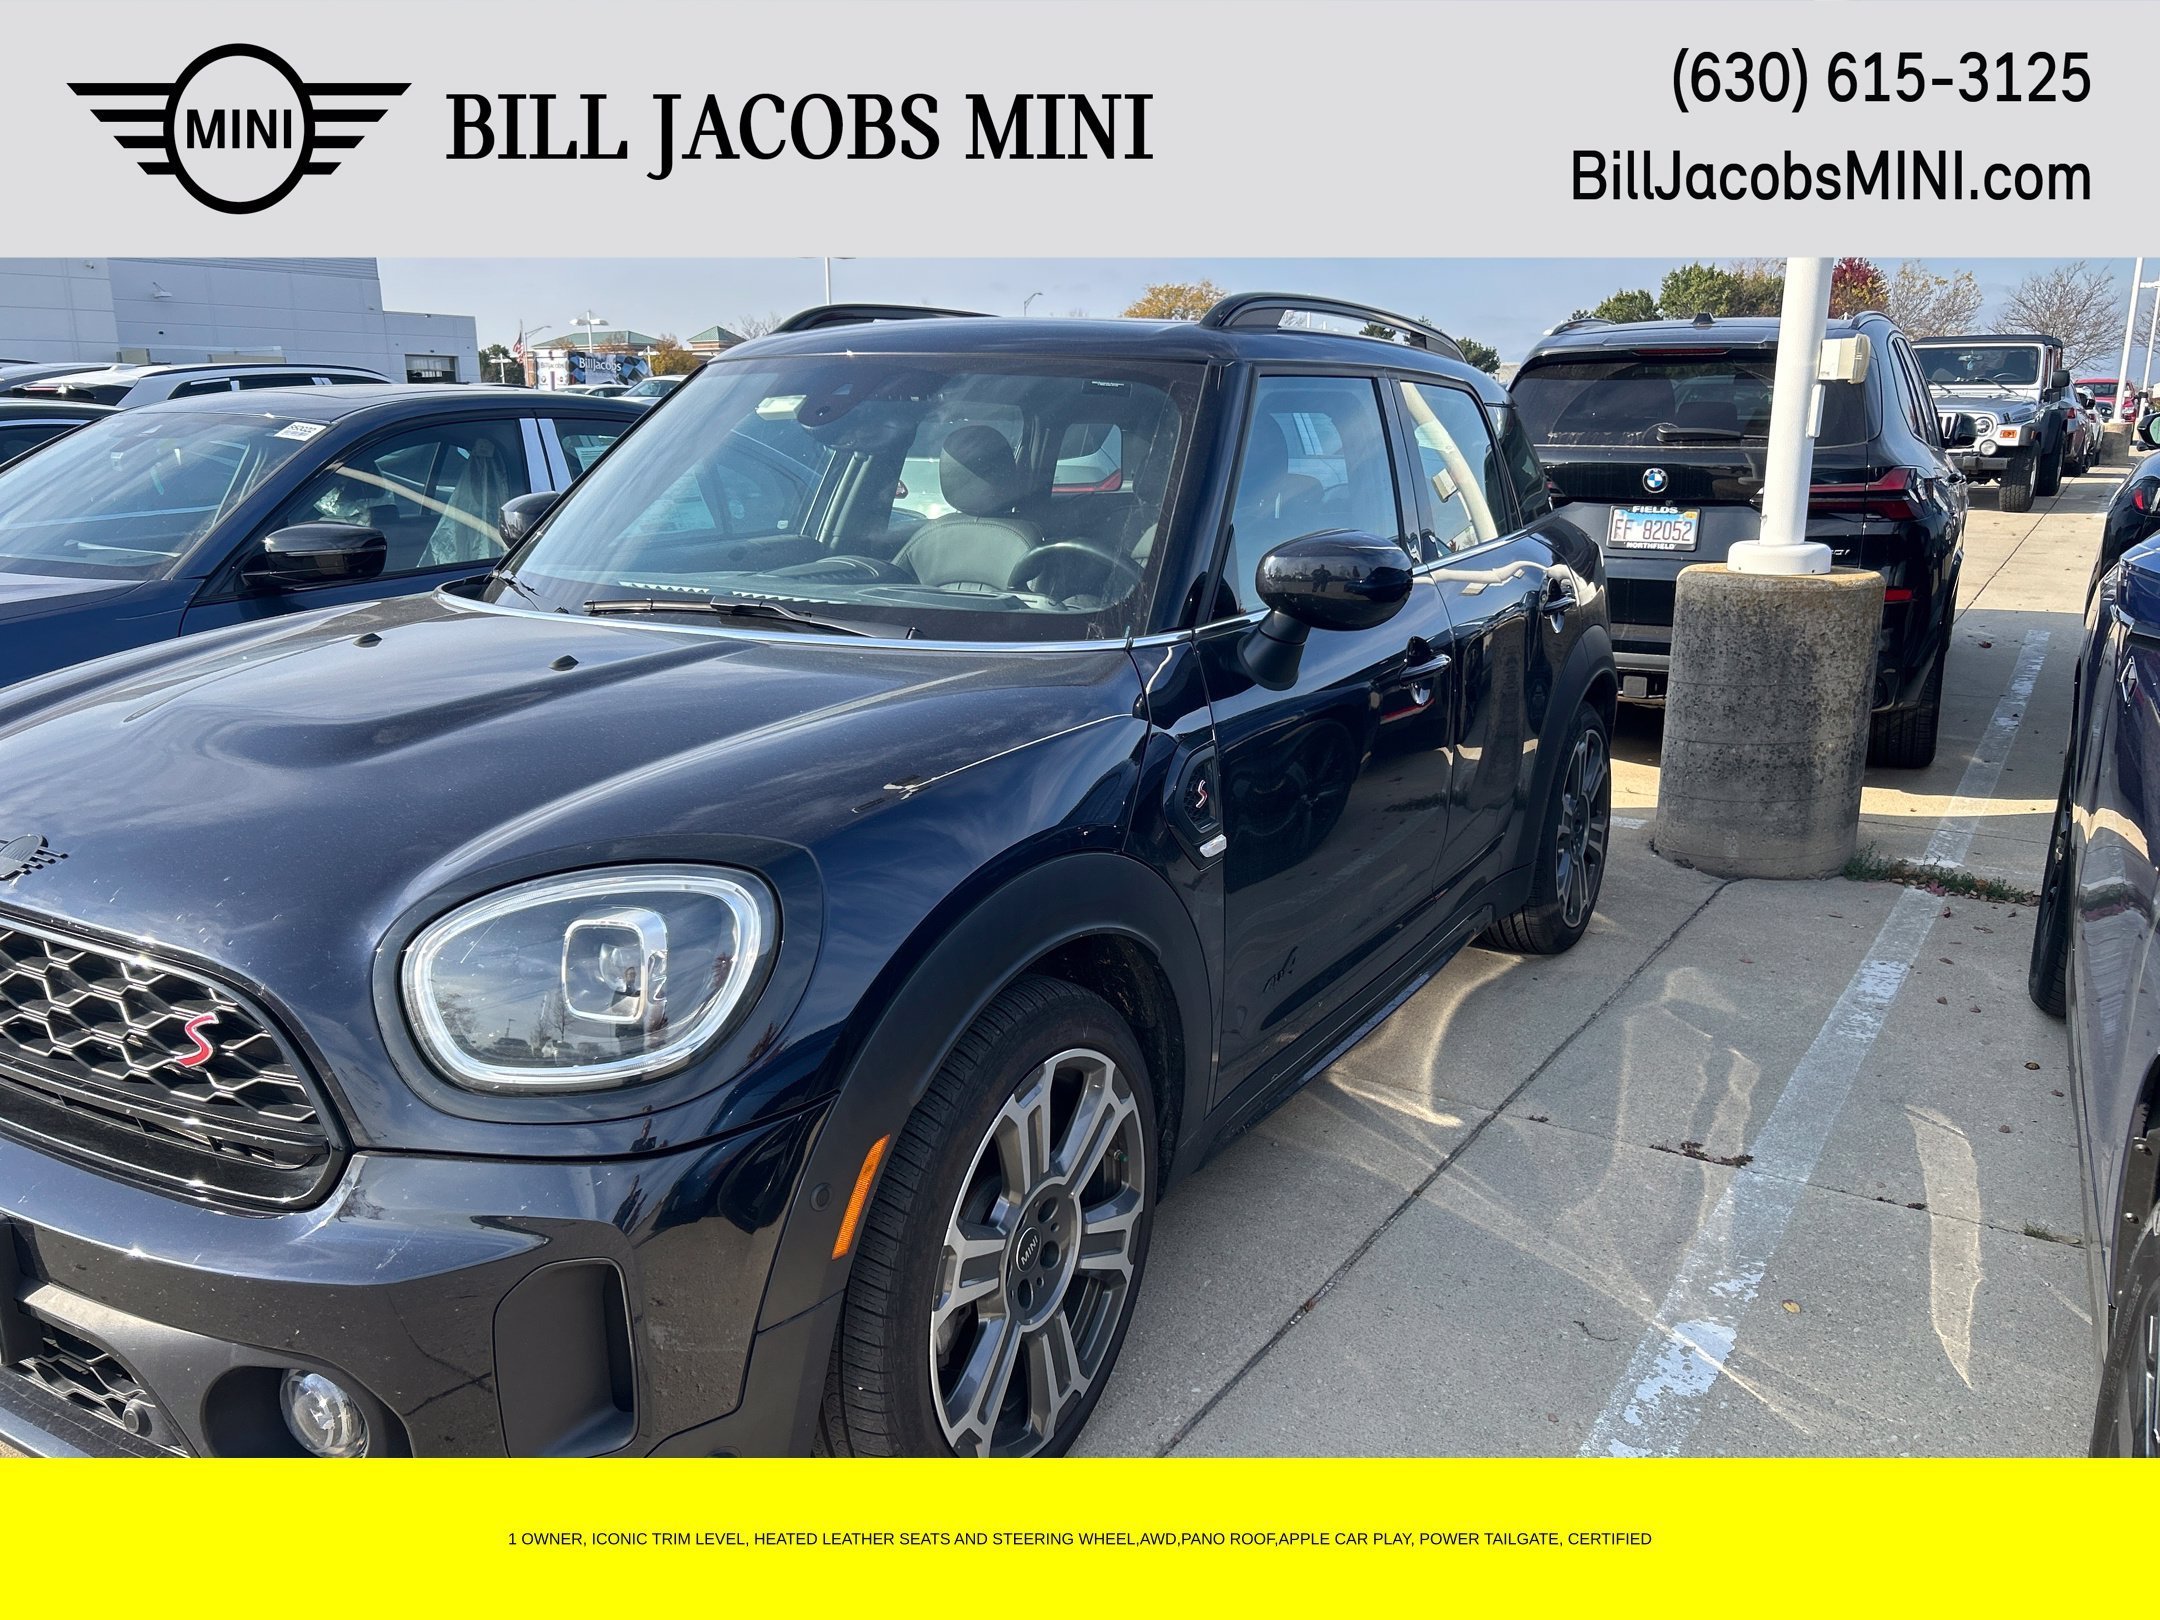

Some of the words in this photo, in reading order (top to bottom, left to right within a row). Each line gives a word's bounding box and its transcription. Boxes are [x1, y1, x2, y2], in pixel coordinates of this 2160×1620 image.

[579, 357, 622, 372] BillJacobs
[1632, 505, 1678, 514] FIELDS
[1642, 519, 1693, 542] 82052
[1626, 541, 1676, 550] NORTHFIELD
[174, 1011, 219, 1068] S
[1020, 1235, 1038, 1265] MINI
